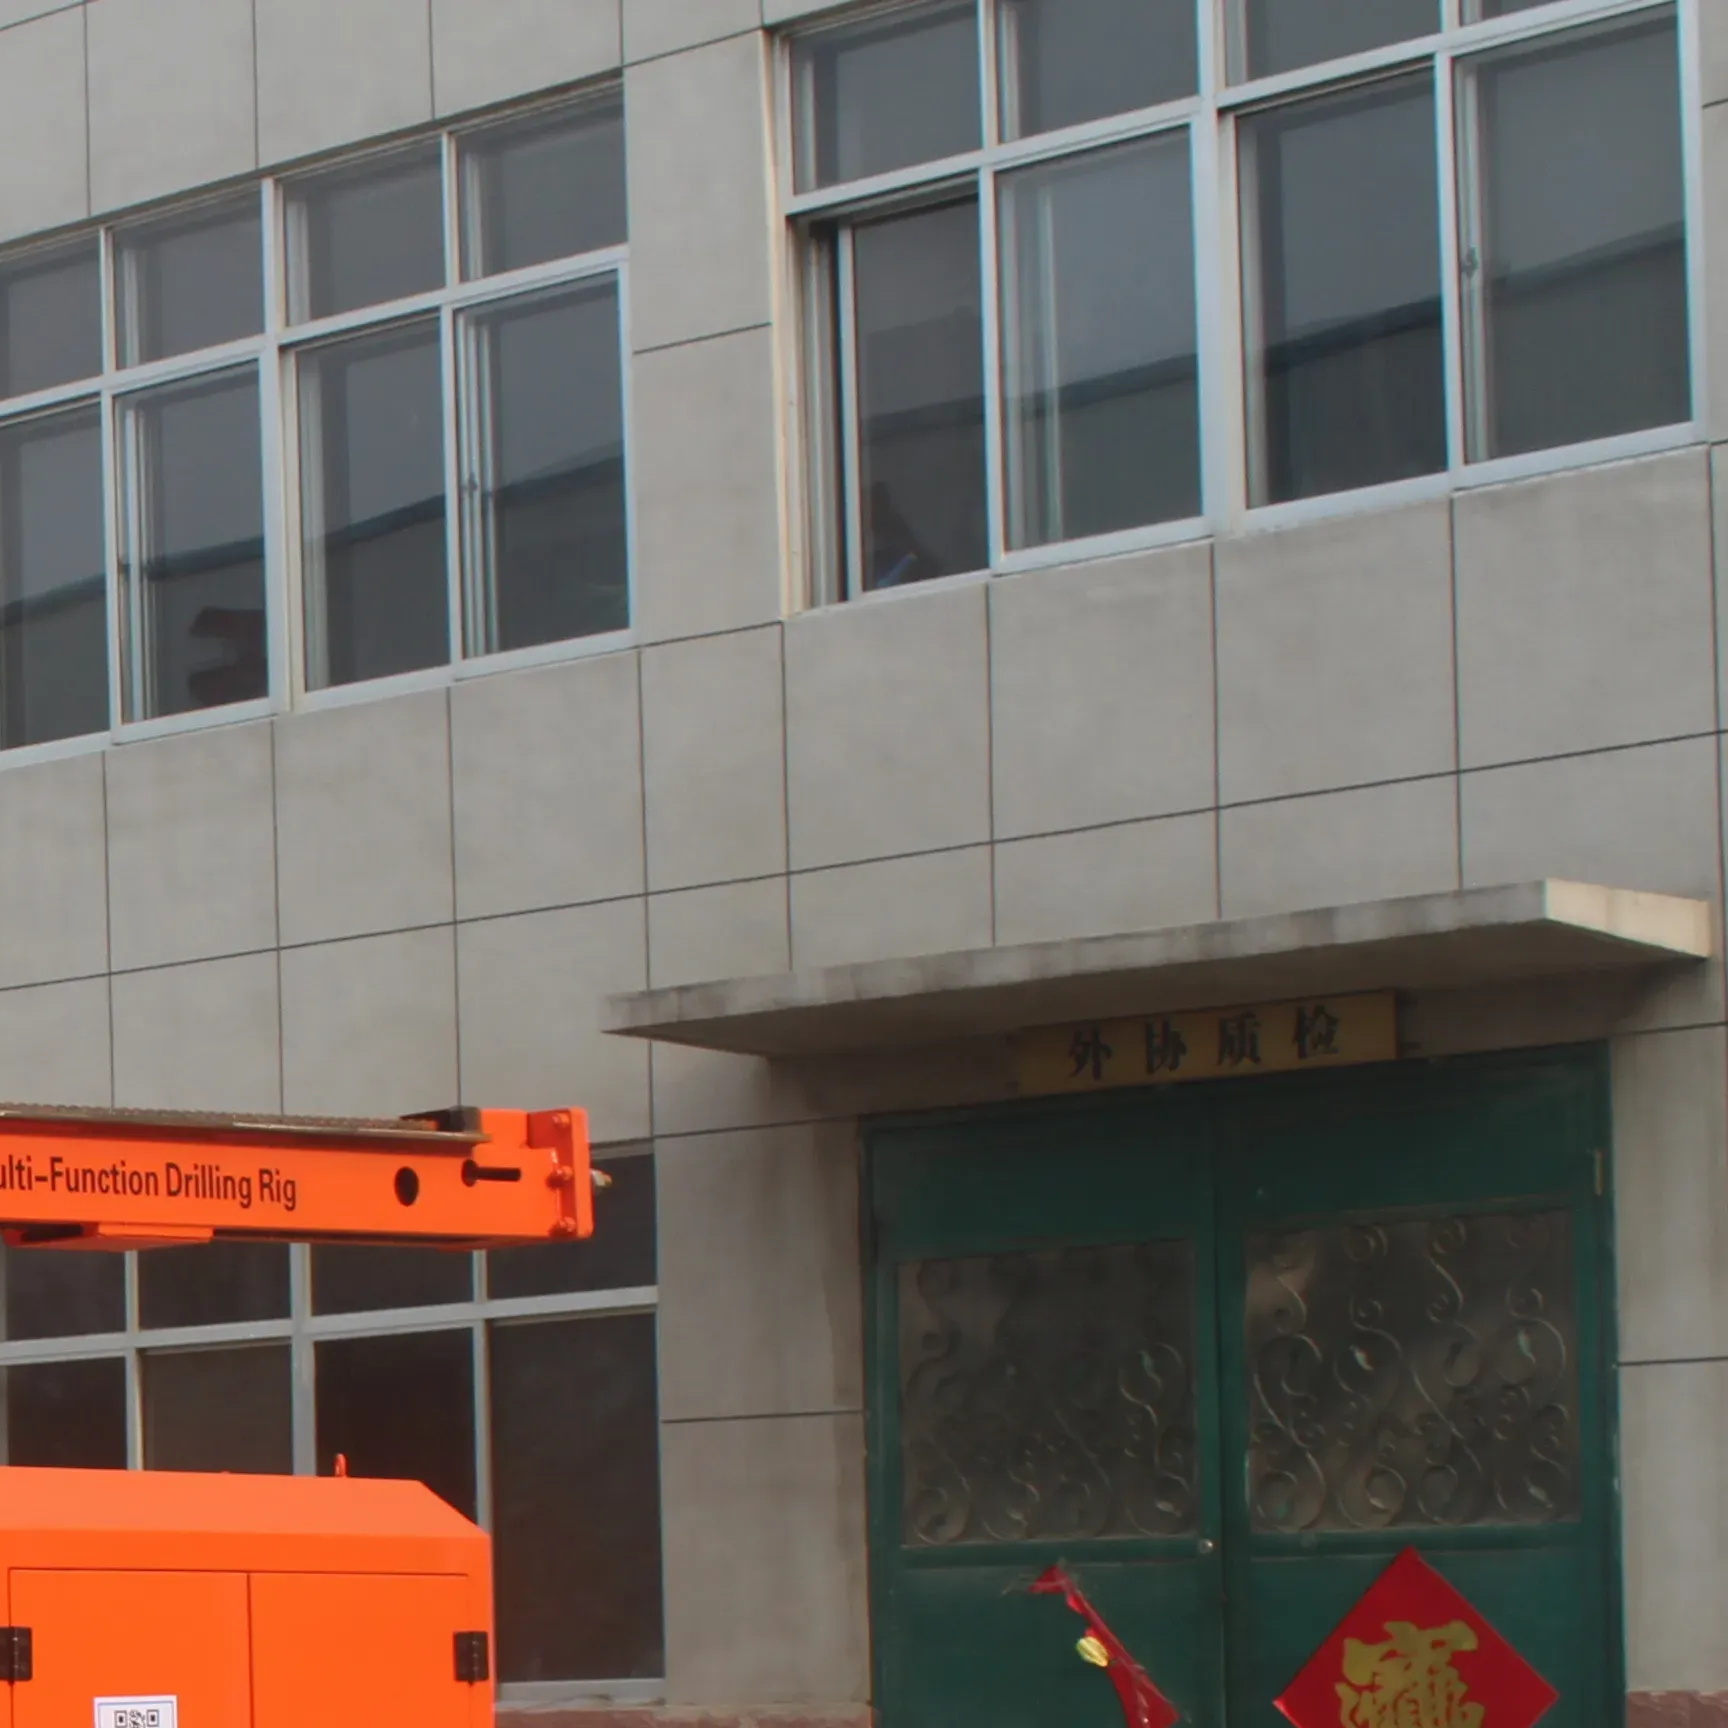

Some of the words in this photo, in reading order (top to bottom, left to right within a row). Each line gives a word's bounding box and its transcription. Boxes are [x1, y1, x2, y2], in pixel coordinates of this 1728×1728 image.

[1067, 1004, 1340, 1081] 外协质检
[165, 1162, 252, 1209] Drilling
[258, 1168, 297, 1211] Rig
